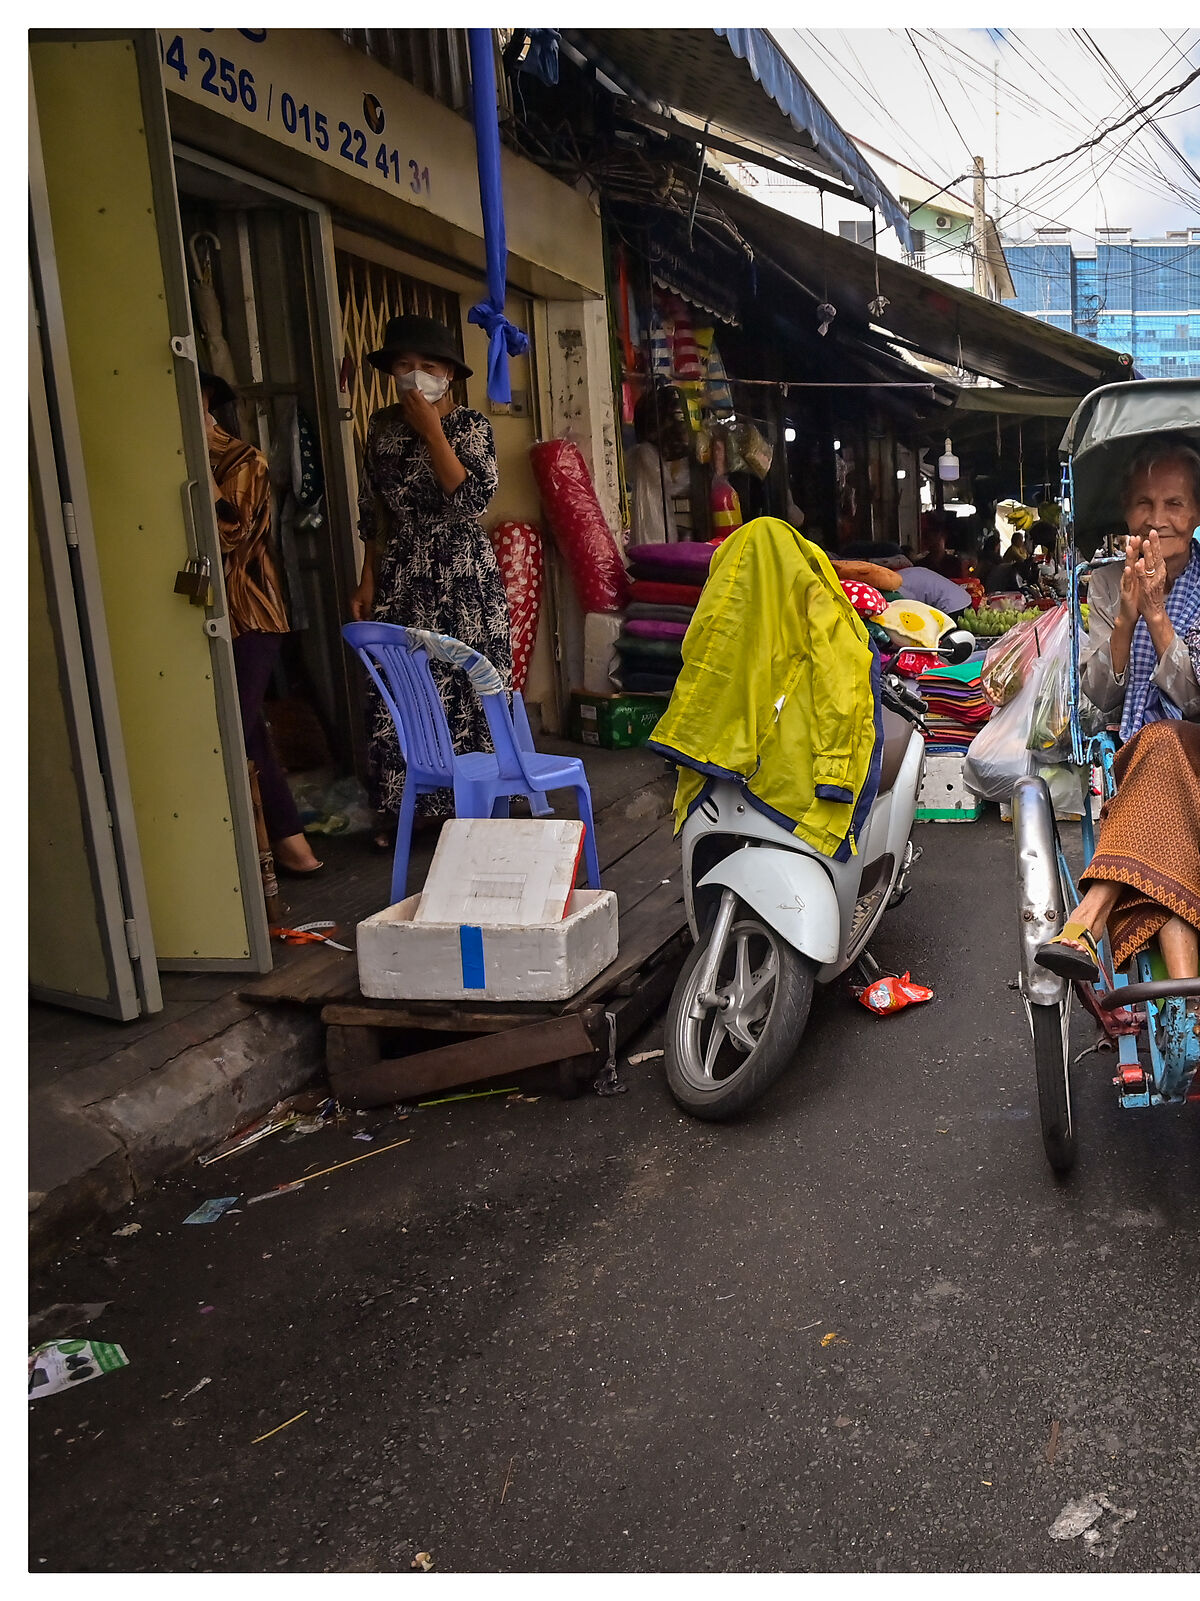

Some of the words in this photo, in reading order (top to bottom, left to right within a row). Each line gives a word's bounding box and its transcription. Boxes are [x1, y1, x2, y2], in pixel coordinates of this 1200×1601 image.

[198, 48, 257, 113] 256
[281, 92, 329, 152] 015
[338, 121, 368, 169] 22
[375, 143, 400, 184] 41
[408, 159, 431, 194] 31
